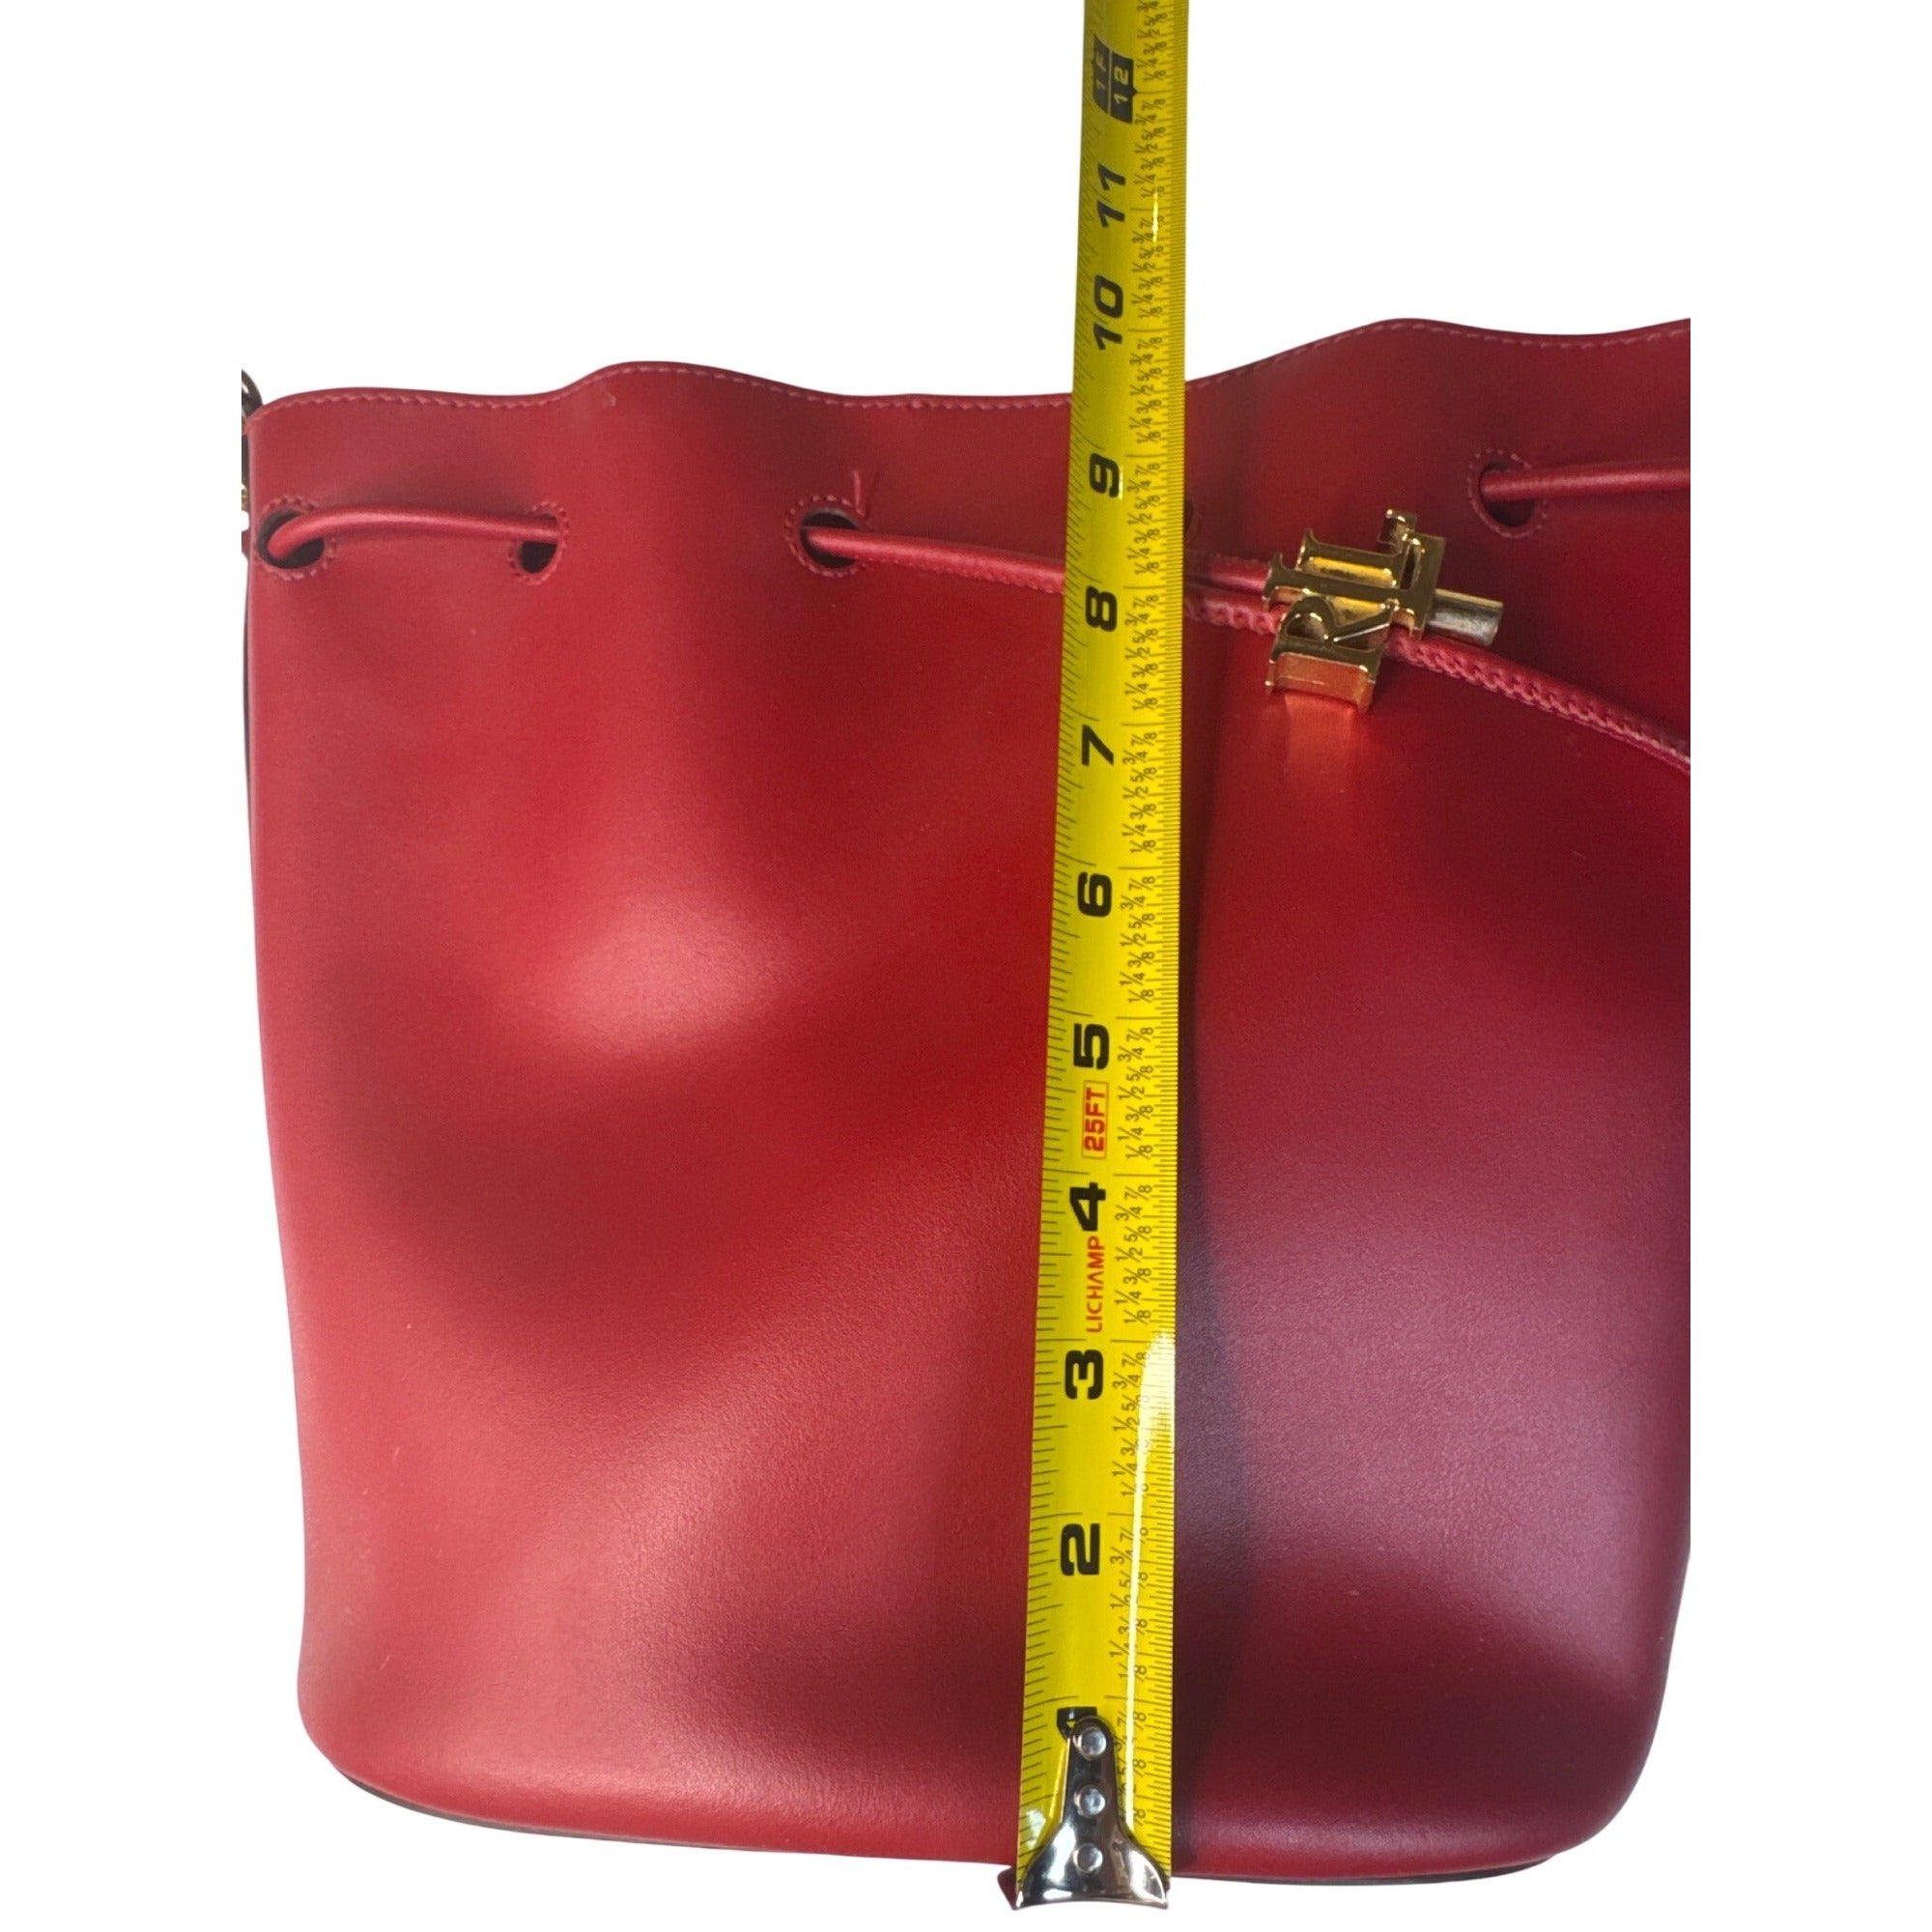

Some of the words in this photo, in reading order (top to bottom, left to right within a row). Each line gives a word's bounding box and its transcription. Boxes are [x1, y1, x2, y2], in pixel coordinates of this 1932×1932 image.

[1113, 66, 1128, 104] 12
[1096, 163, 1125, 227] 11
[1094, 274, 1123, 351] 10
[1088, 454, 1120, 498] 9
[1085, 585, 1118, 632] 8
[1081, 725, 1114, 767] 7
[1077, 872, 1112, 918] 6
[1073, 1022, 1110, 1070] 5
[1083, 1087, 1106, 1151] 25FT
[1068, 1182, 1106, 1232] 4
[1086, 1236, 1105, 1333] LICHAMP
[1065, 1350, 1104, 1400] 3
[1060, 1523, 1100, 1577] 2
